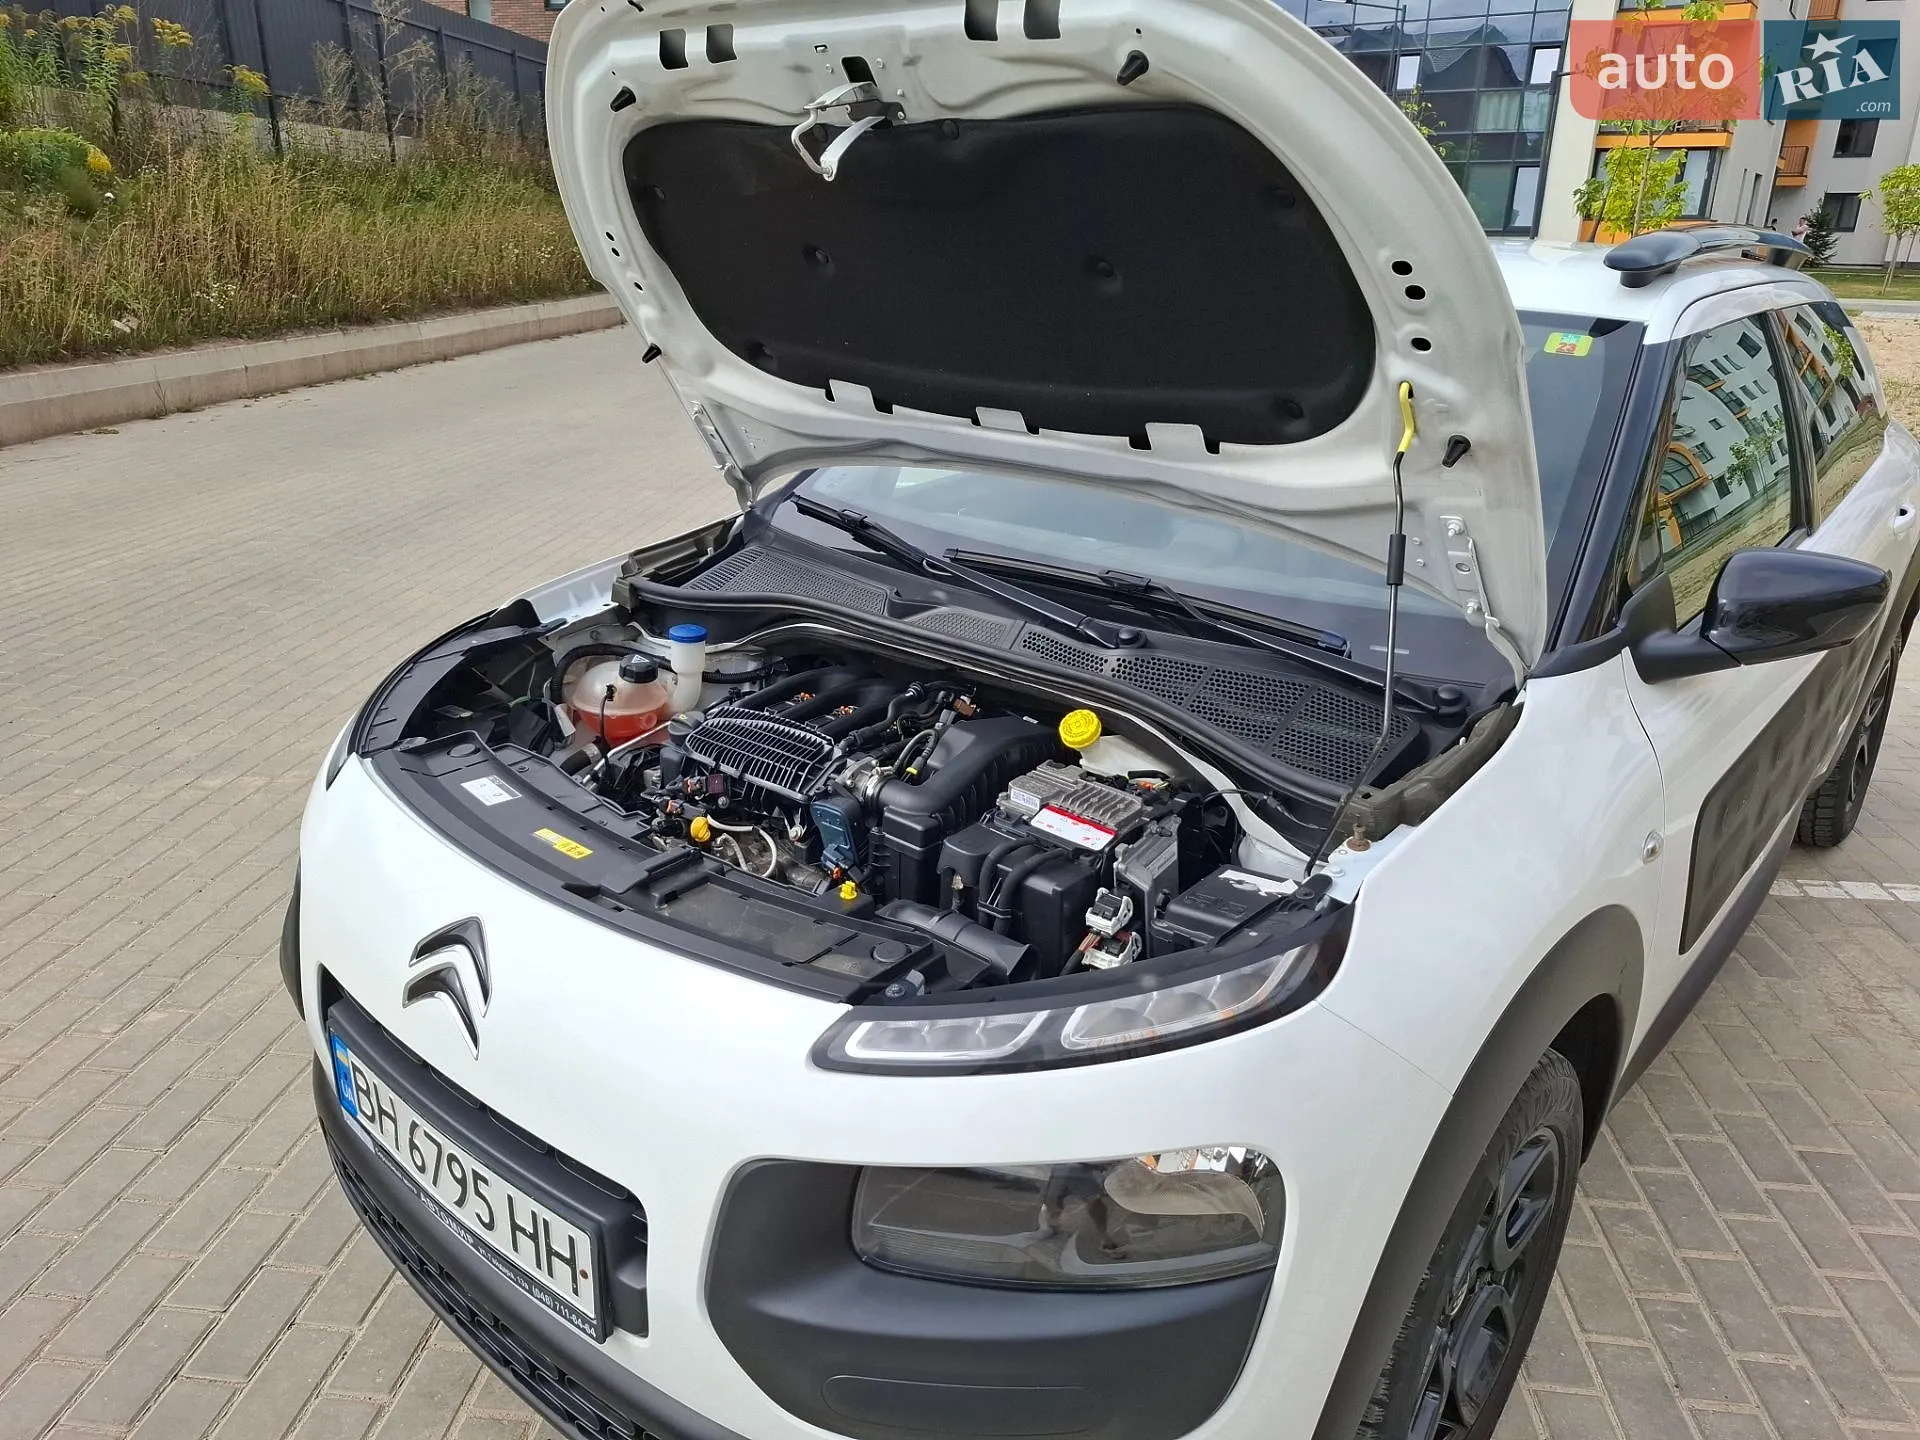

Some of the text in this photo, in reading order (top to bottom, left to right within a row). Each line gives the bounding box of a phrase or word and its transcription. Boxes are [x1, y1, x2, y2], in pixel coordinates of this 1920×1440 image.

[340, 1079, 356, 1105] UA
[351, 1060, 400, 1152] BH
[408, 1118, 496, 1233] 6795
[507, 1193, 579, 1298] HH
